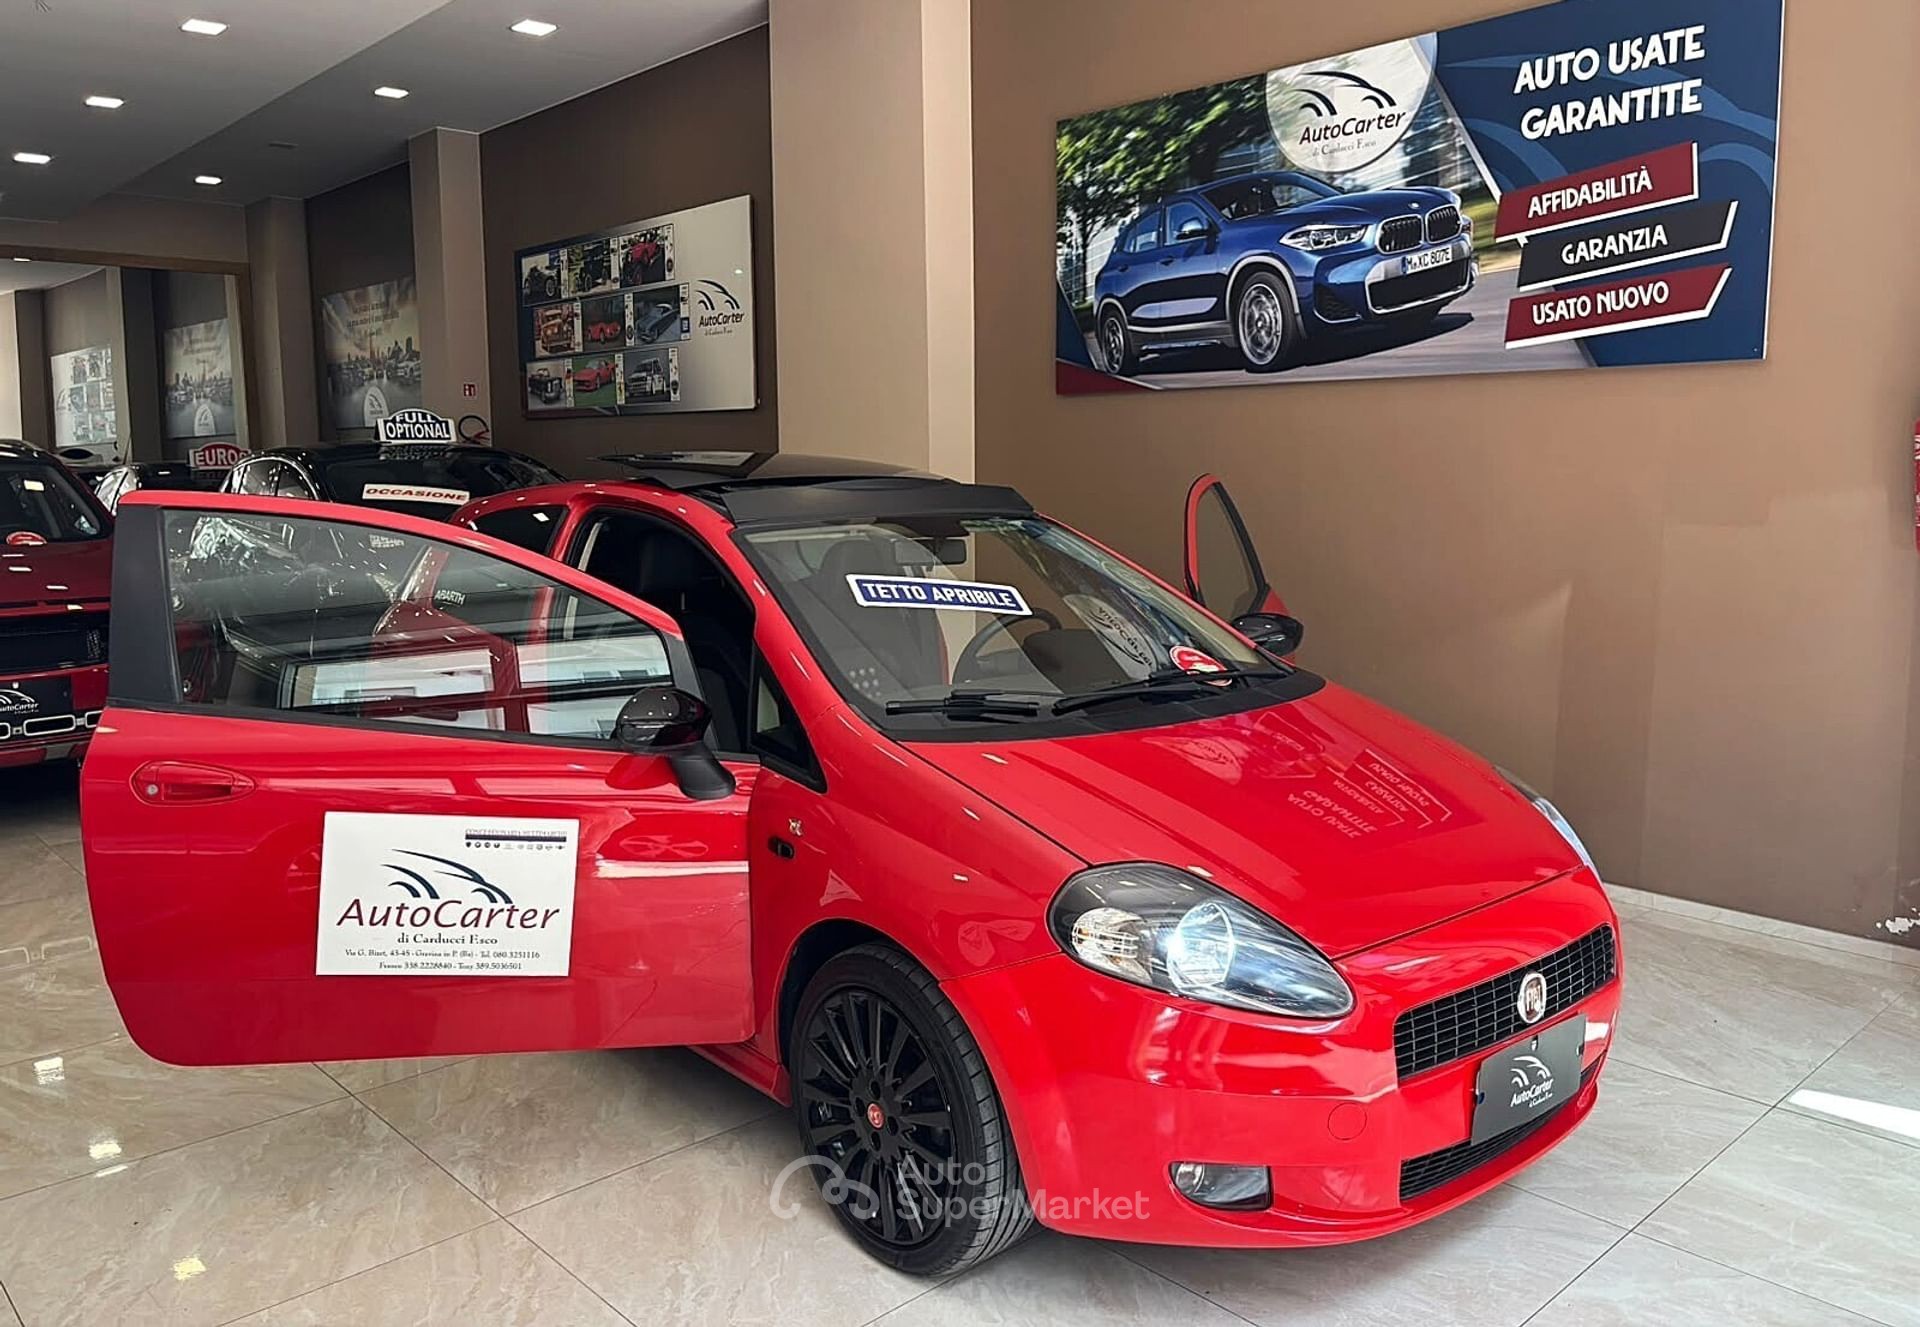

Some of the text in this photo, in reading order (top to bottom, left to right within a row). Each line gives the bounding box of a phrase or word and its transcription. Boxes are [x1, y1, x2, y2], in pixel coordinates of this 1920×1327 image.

[1513, 25, 1705, 94] AUTO USATE
[1520, 78, 1702, 140] GARANTITE
[1299, 111, 1406, 145] AutoCarter
[1527, 165, 1653, 219] AFFIDABILITÀ
[1561, 224, 1668, 265] GARANZIA
[1532, 281, 1670, 325] USATO NUOVO
[698, 312, 745, 328] AutoCarter
[385, 422, 450, 439] OPTIONAL
[395, 412, 436, 423] FULL
[365, 488, 467, 501] OCCASIONE
[433, 589, 465, 605] ABARTH
[862, 583, 1017, 608] TETTO APRIBILE
[337, 898, 560, 929] AutoCarter
[397, 932, 409, 944] di
[413, 932, 465, 944] Carducci
[1510, 1078, 1554, 1108] AutoCarter
